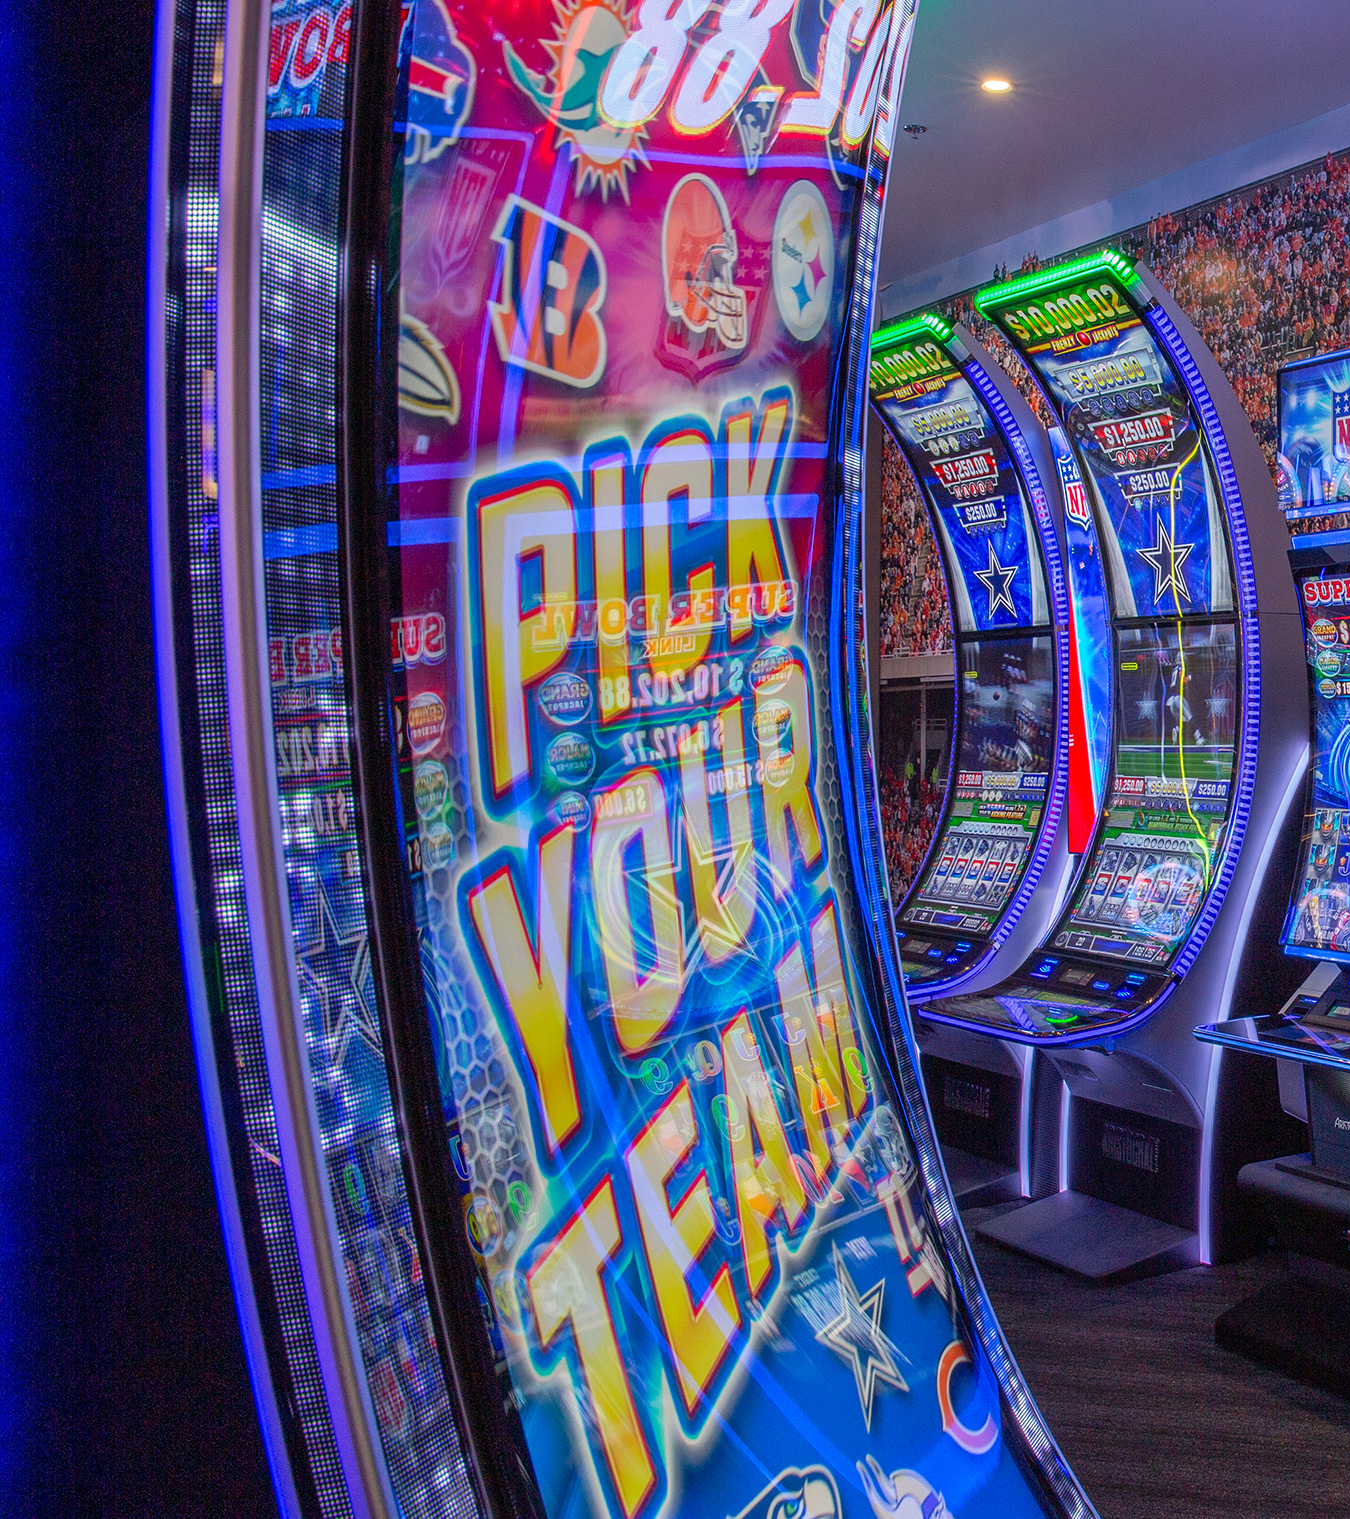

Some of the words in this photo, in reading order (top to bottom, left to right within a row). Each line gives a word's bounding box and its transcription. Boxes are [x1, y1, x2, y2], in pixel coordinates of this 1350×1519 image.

[1003, 283, 1132, 342] $10,000.02
[1050, 336, 1077, 352] FRENZY
[1091, 325, 1121, 343] JACKPOTS
[1070, 355, 1146, 393] $5,000.00
[893, 387, 913, 400] FRENZY
[910, 402, 970, 436] $5,000.00
[1103, 416, 1165, 449] $1,250.00
[942, 455, 990, 483] $1,250.00
[1129, 470, 1171, 493] $250.00
[965, 502, 997, 522] $250.00
[477, 395, 792, 800] PICK
[1312, 625, 1337, 636] GRAND
[1113, 779, 1145, 792] $1,250.00
[1198, 784, 1227, 797] $250.00
[468, 658, 823, 1160] YOUR
[526, 899, 936, 1519] TEAM!
